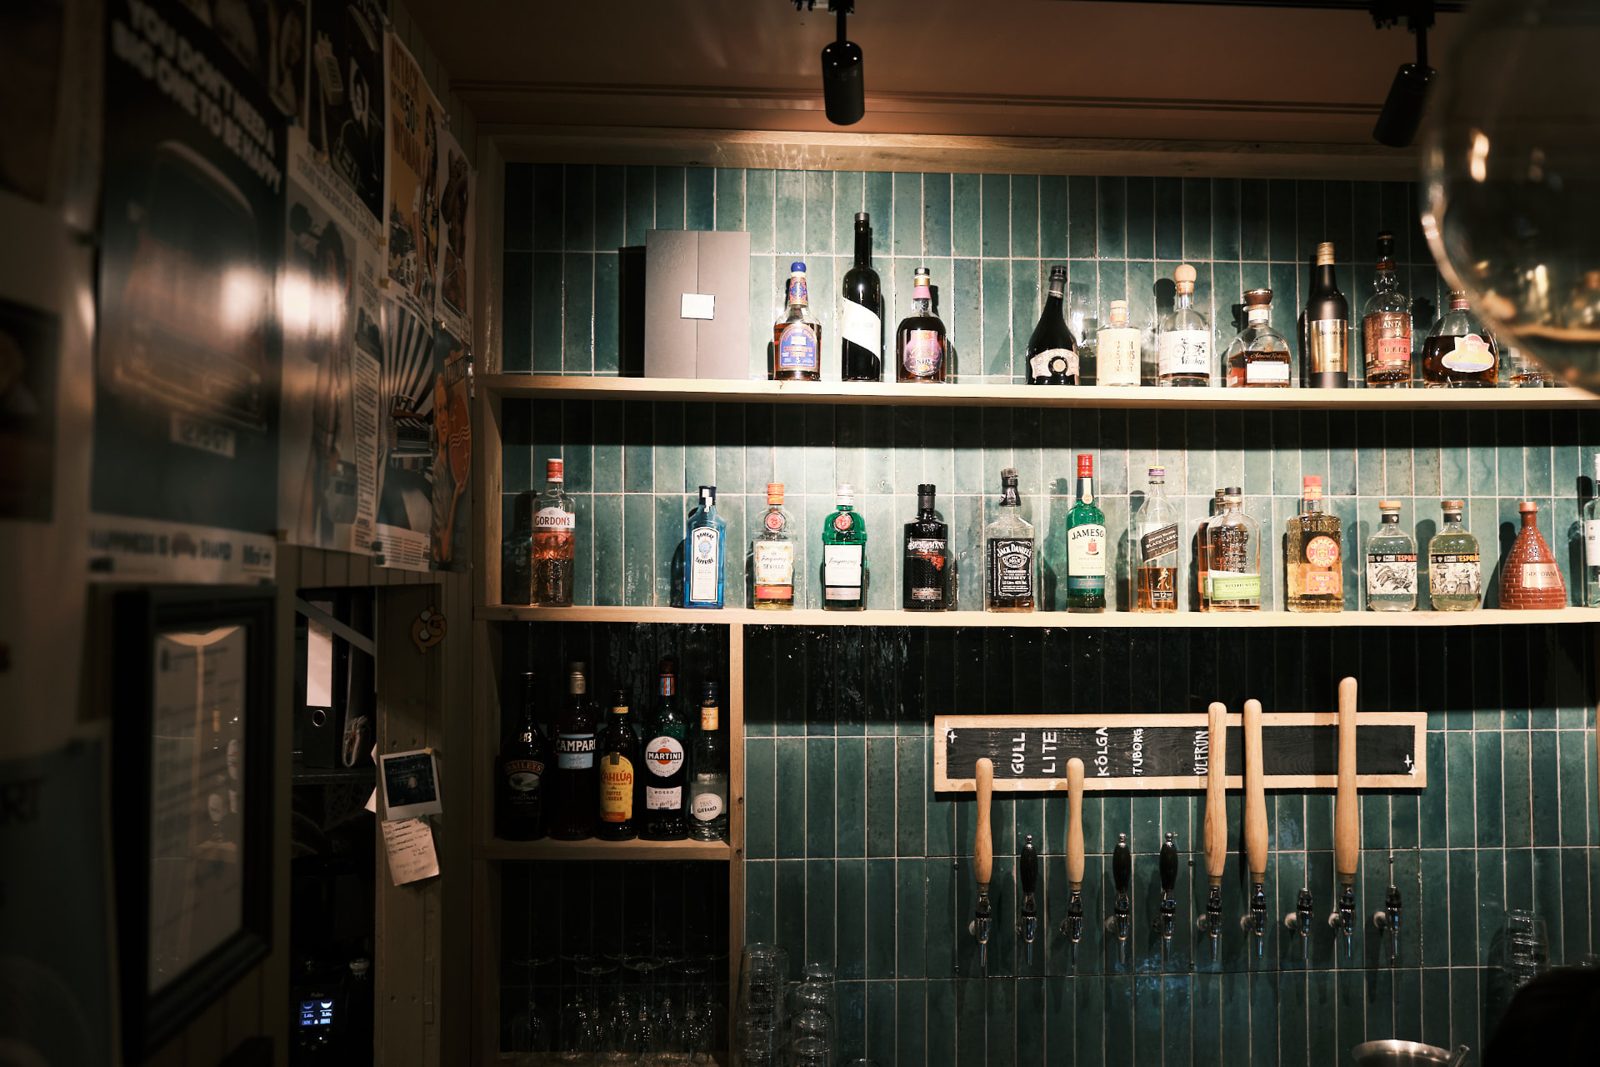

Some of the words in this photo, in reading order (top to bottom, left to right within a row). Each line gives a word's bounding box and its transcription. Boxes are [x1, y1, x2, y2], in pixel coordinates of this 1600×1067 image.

[996, 545, 1011, 557] JACK
[647, 752, 682, 760] MARTINI
[1011, 732, 1026, 775] GULL
[1042, 731, 1057, 774] LITE
[1094, 727, 1110, 777] KÓLGA
[1132, 728, 1144, 776] TUBORG
